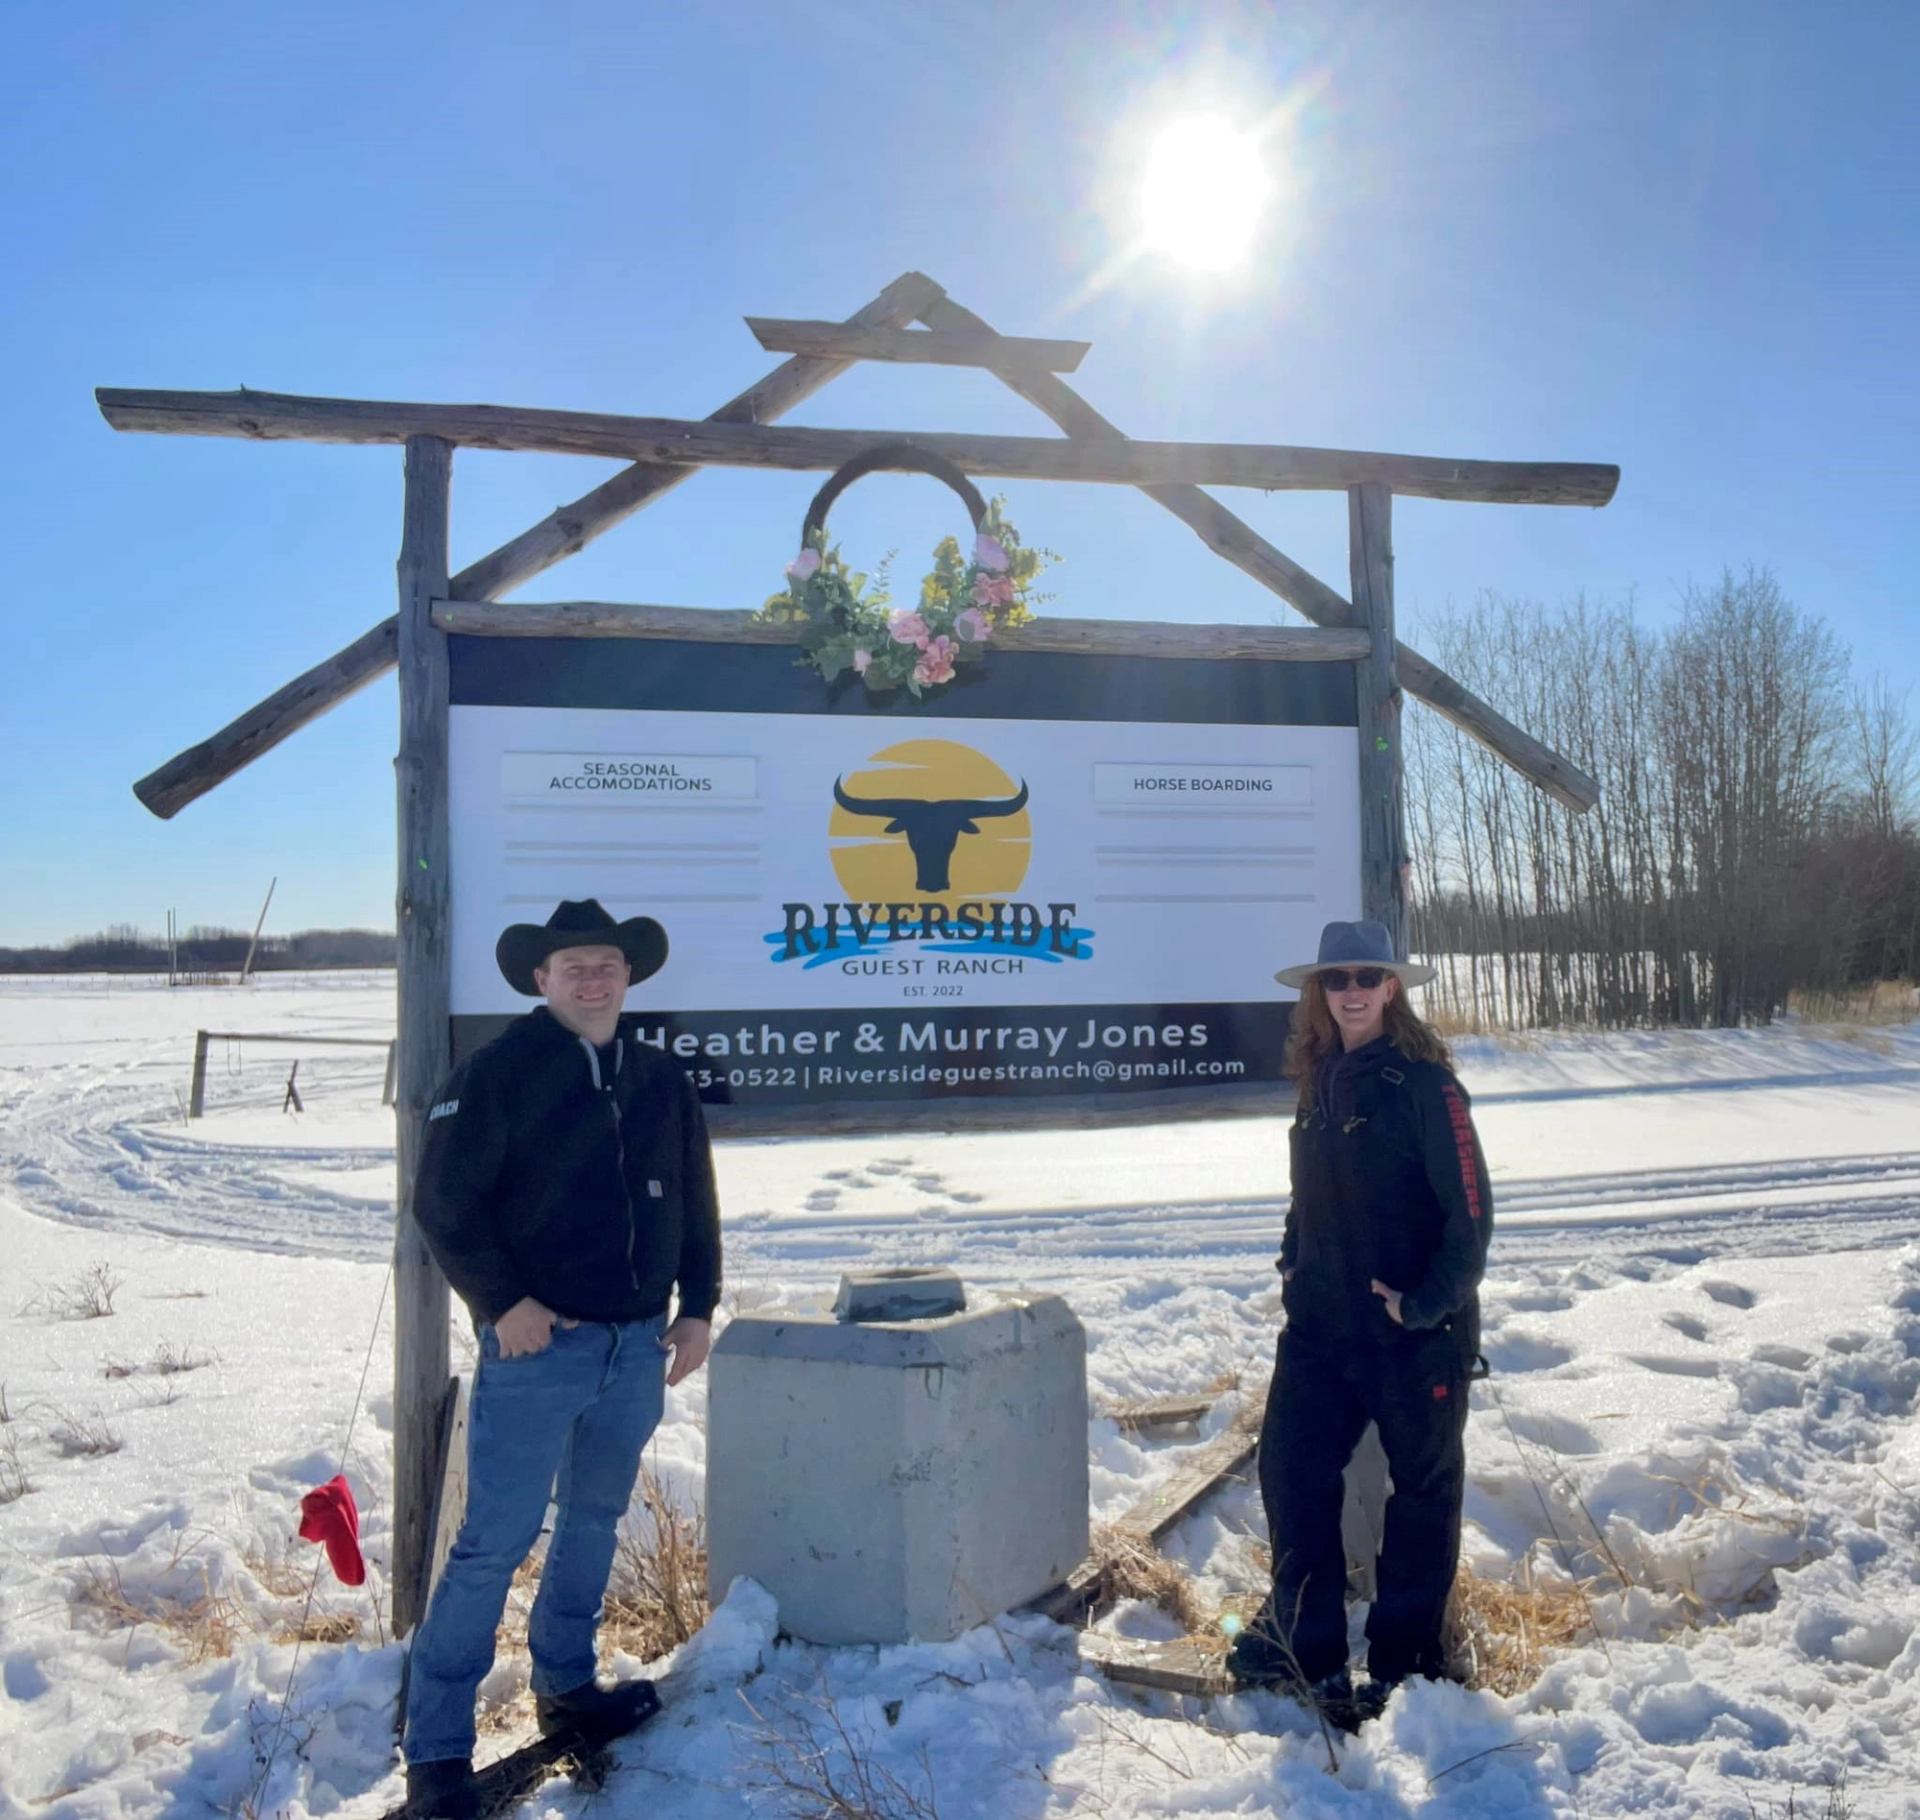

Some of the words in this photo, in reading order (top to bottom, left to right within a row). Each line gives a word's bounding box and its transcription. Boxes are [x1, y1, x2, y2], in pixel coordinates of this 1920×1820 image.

[583, 762, 680, 776] SEASONAL
[549, 776, 712, 791] ACCOMODATIONS
[1134, 778, 1187, 791] HORSE
[1191, 779, 1273, 792] BOARDING
[781, 902, 1078, 960] RIVERSIDE
[842, 959, 924, 976] GUEST
[937, 958, 1024, 975] RANCH
[932, 985, 963, 997] 2022
[637, 1023, 841, 1057] Heather
[854, 1022, 884, 1053] &
[899, 1020, 1068, 1057] Murray
[1077, 1019, 1209, 1049] Jones
[818, 1058, 1245, 1086] Riversideguestranch@gmail.com
